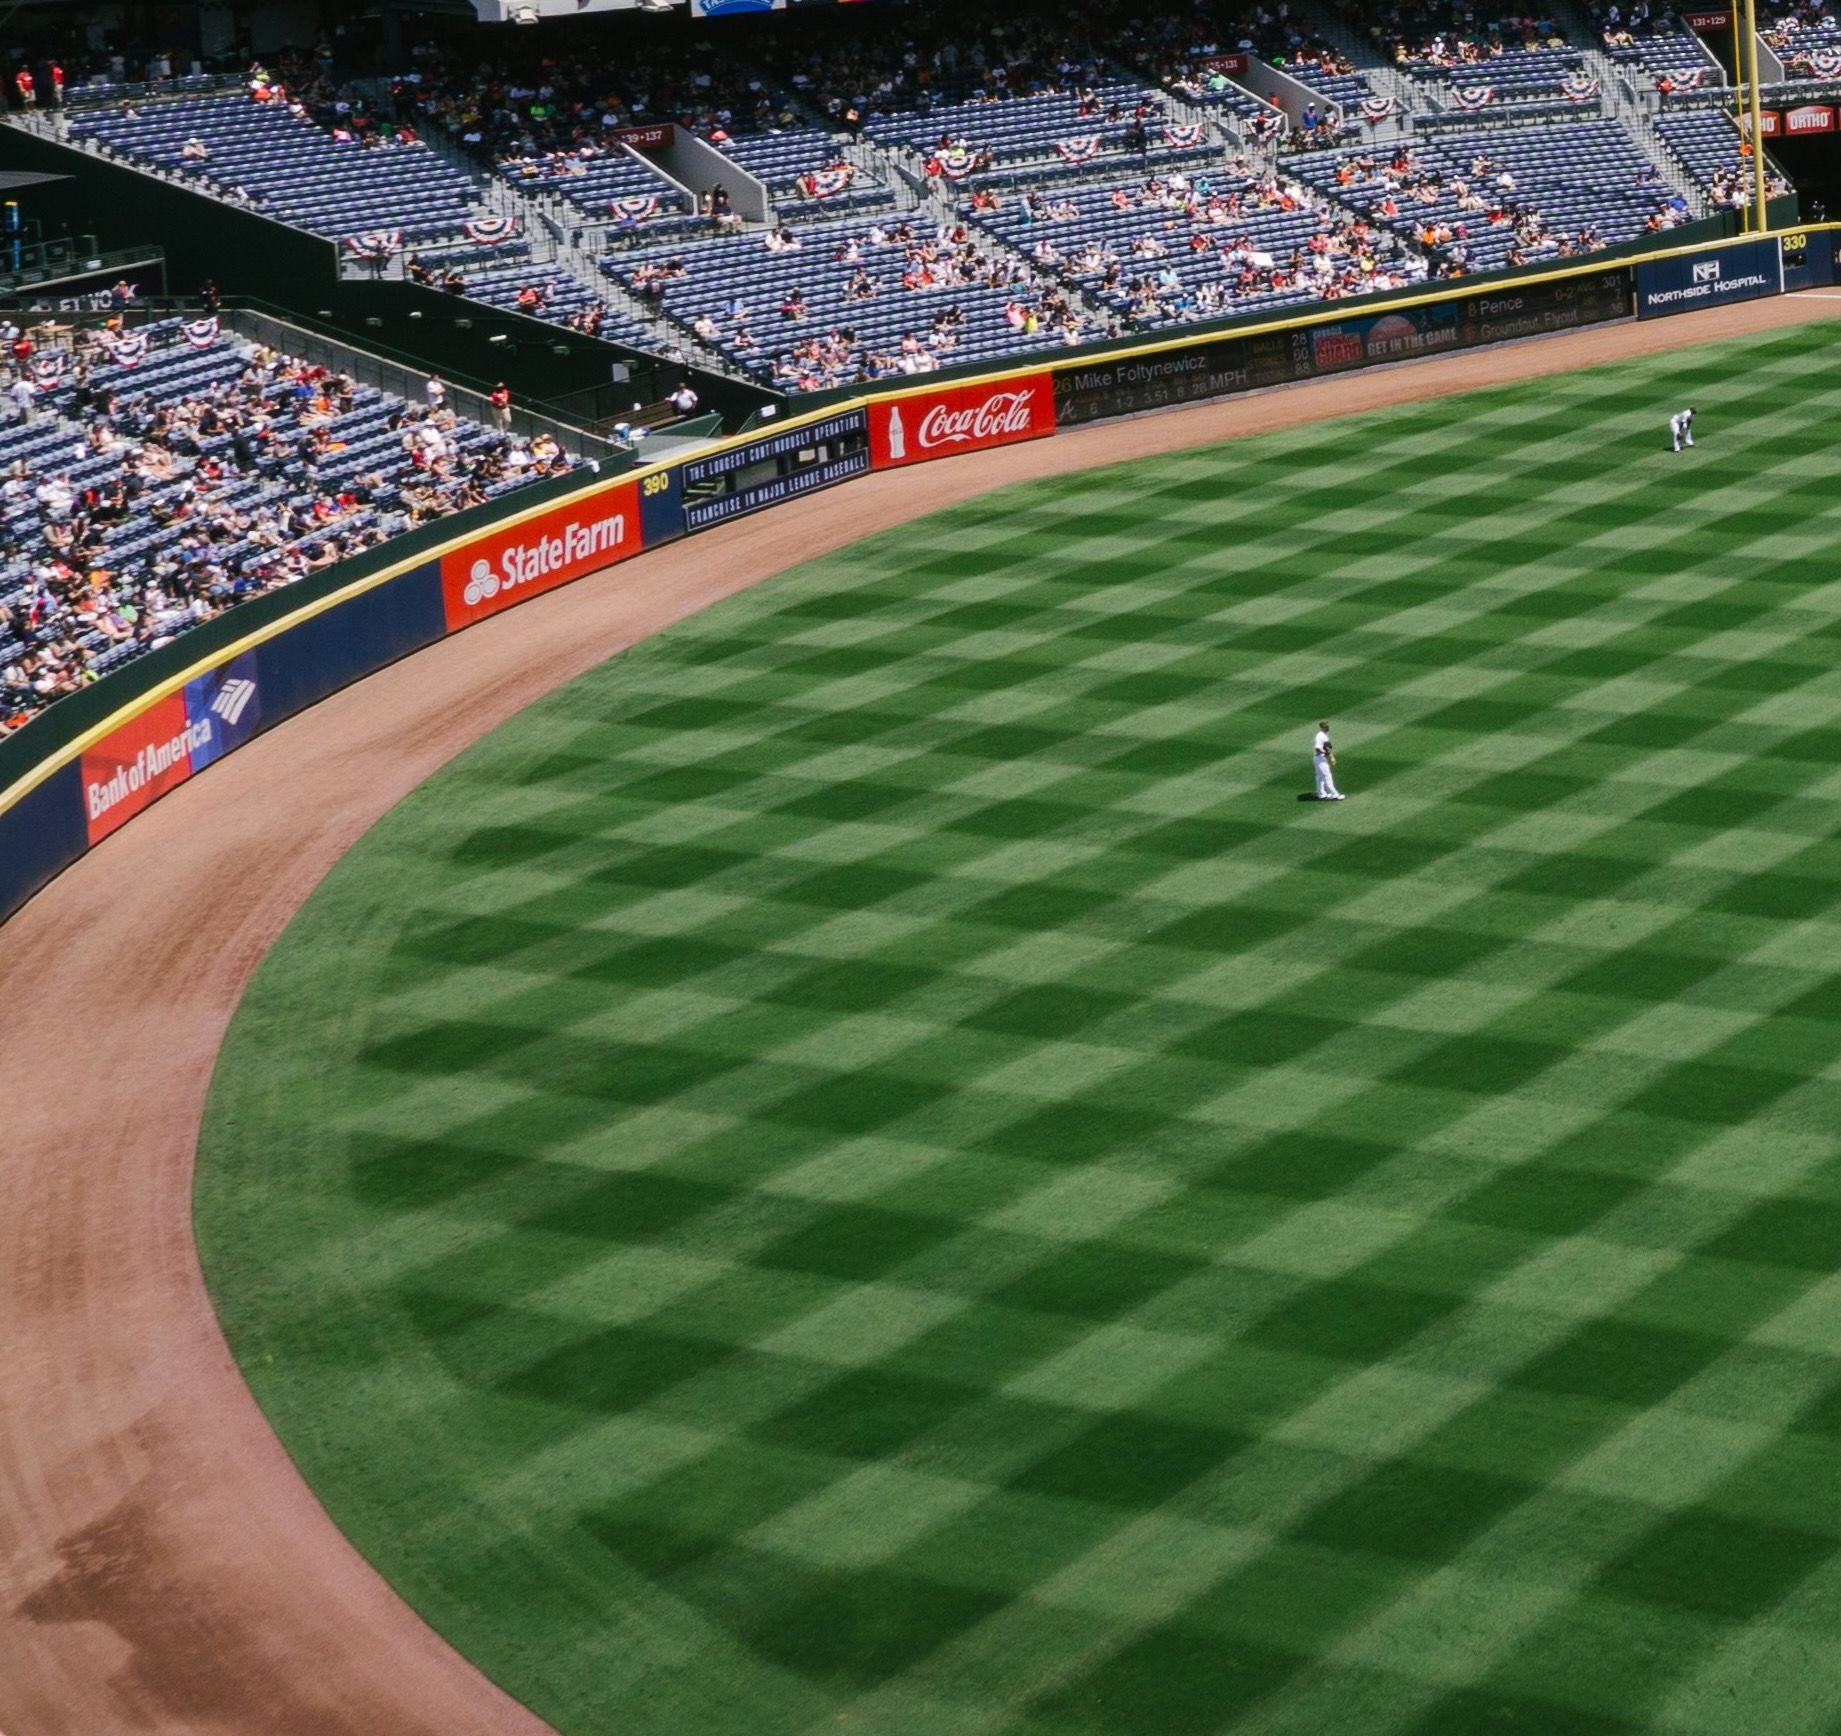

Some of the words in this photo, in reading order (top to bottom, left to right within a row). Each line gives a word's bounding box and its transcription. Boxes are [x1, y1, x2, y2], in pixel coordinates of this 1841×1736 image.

[1790, 112, 1829, 130] ORTHO
[1783, 234, 1806, 251] 330
[1480, 296, 1524, 314] Pence
[1648, 284, 1711, 305] NORTHSIDE
[1714, 274, 1766, 293] HOSPITAL
[1074, 372, 1112, 391] Mike
[1116, 354, 1206, 383] Foltynewicz
[1210, 369, 1248, 391] MPH
[918, 388, 1036, 448] Coca-Cola
[690, 462, 704, 481] THE
[709, 451, 746, 475] LONGEST
[750, 430, 810, 462] CONTINUOUSLY
[814, 414, 860, 442] OPERATING
[643, 472, 669, 497] 390
[690, 498, 741, 525] FRANCHISE
[745, 492, 756, 506] IN
[758, 482, 786, 503] MAJOR
[789, 470, 820, 492] LEAGUE
[824, 455, 866, 476] BASEBALL
[88, 764, 130, 821] Bank
[128, 750, 146, 792] of
[145, 718, 212, 781] America
